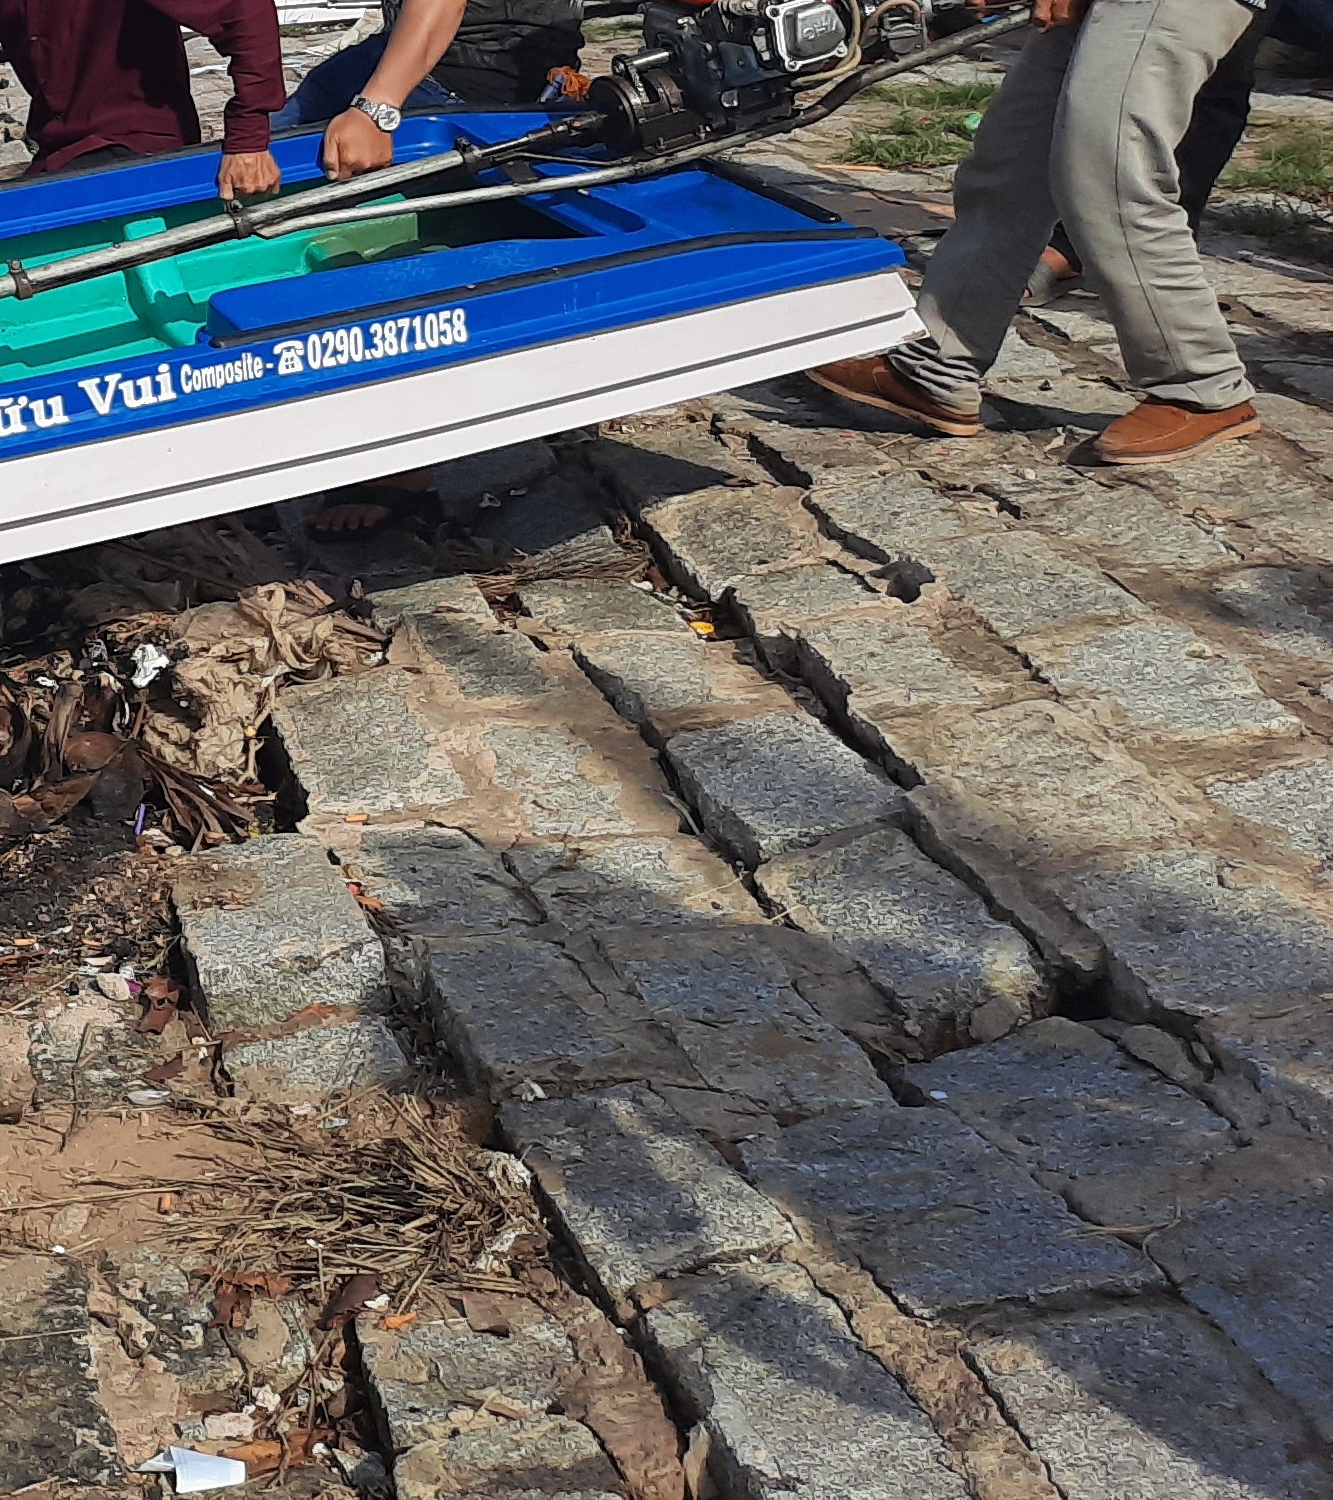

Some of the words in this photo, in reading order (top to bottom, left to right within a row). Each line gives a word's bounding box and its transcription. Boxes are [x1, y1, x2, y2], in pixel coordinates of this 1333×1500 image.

[77, 363, 178, 416] Vui
[181, 353, 264, 394] Composite
[306, 308, 469, 369] 0290.3871058
